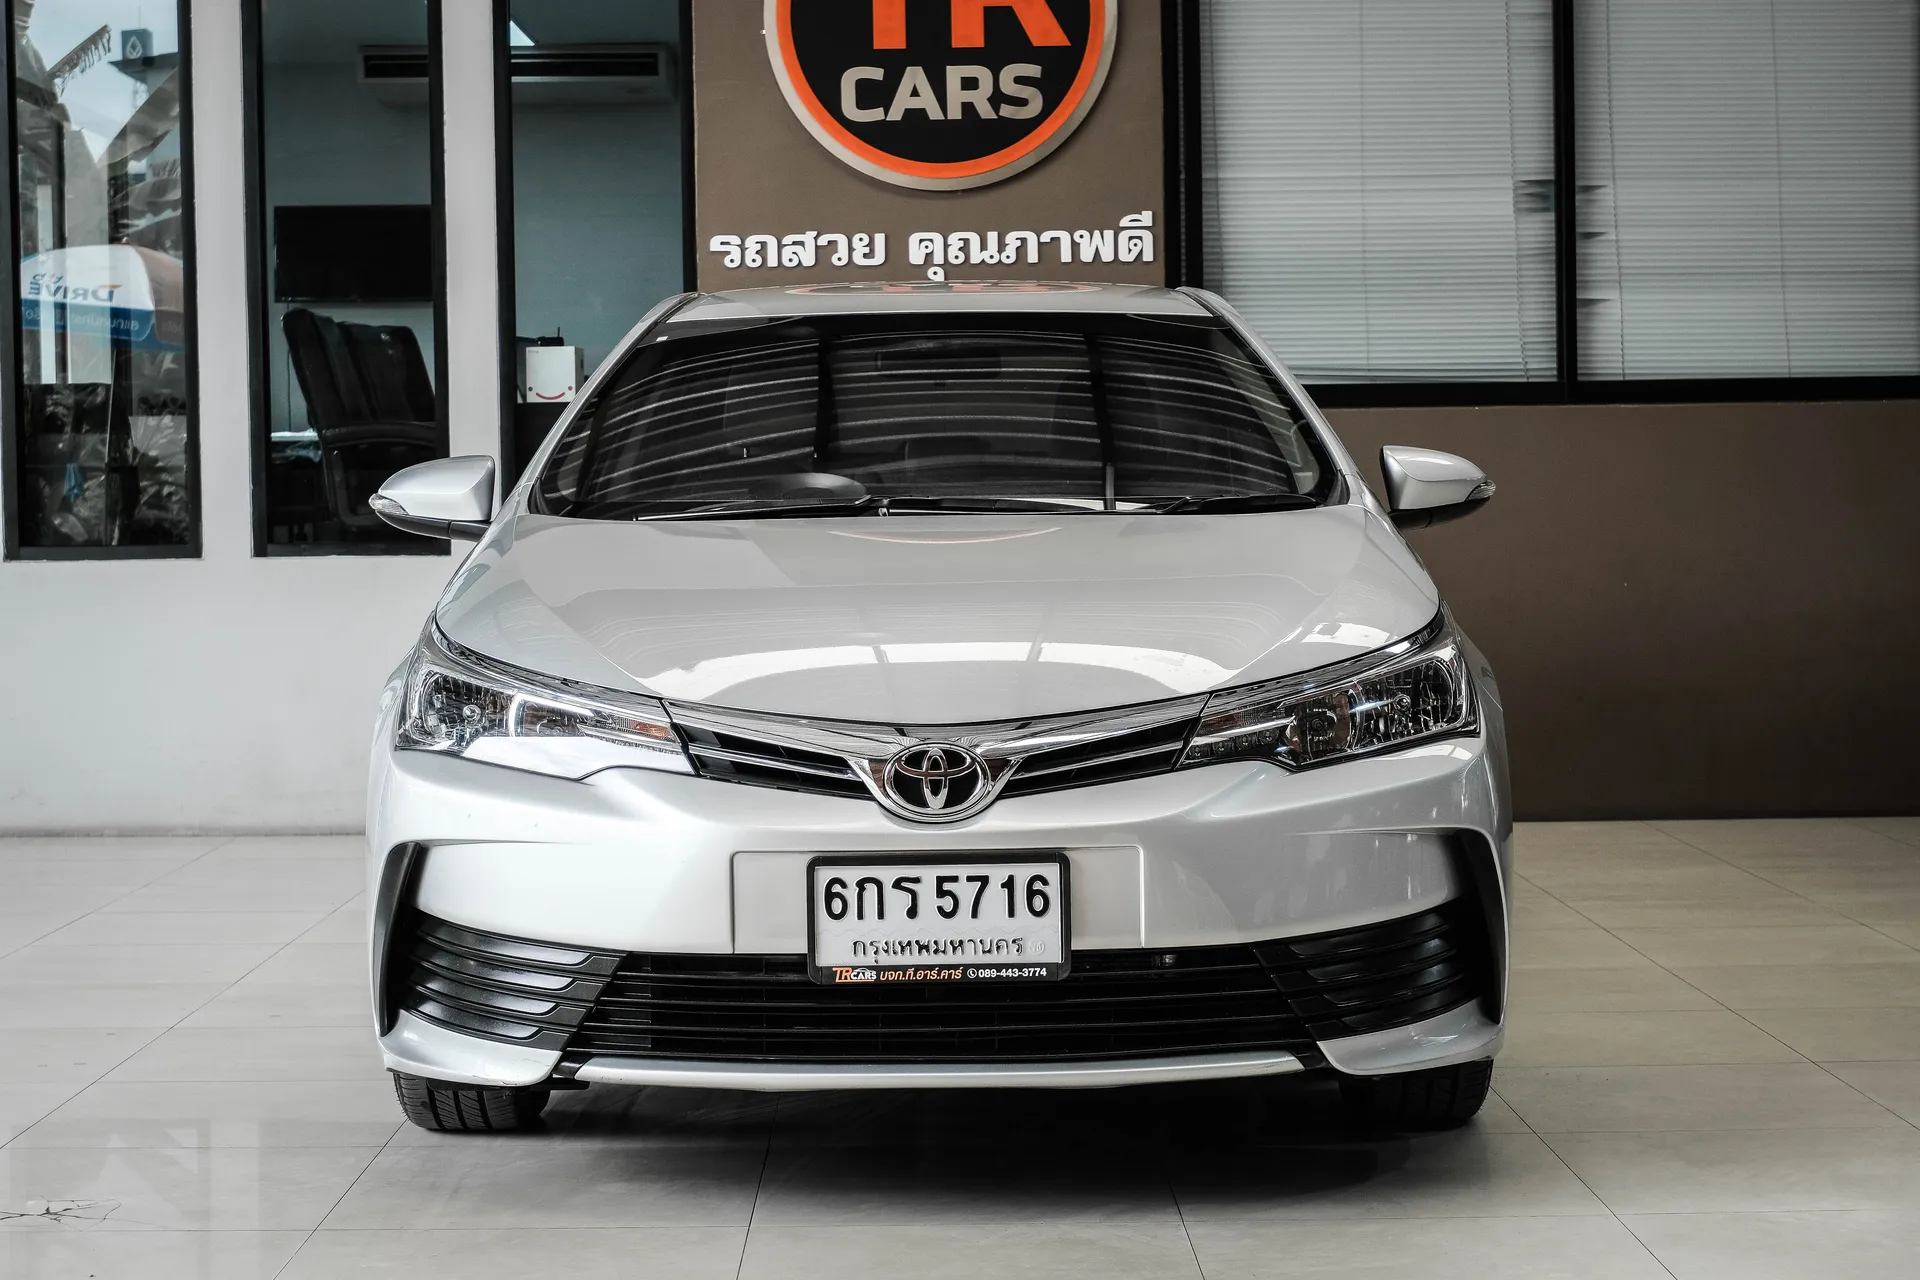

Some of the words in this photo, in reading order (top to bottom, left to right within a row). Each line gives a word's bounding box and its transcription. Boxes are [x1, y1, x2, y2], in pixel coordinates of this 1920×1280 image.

[840, 63, 1043, 123] CARS
[709, 230, 886, 269] รถสวย
[908, 211, 1155, 281] คุณภาพดี
[823, 876, 921, 921] 6กร
[935, 874, 1051, 920] 5716
[852, 938, 1023, 964] กรุงเทพมหานคร
[978, 967, 1047, 978] 089-443-3774
